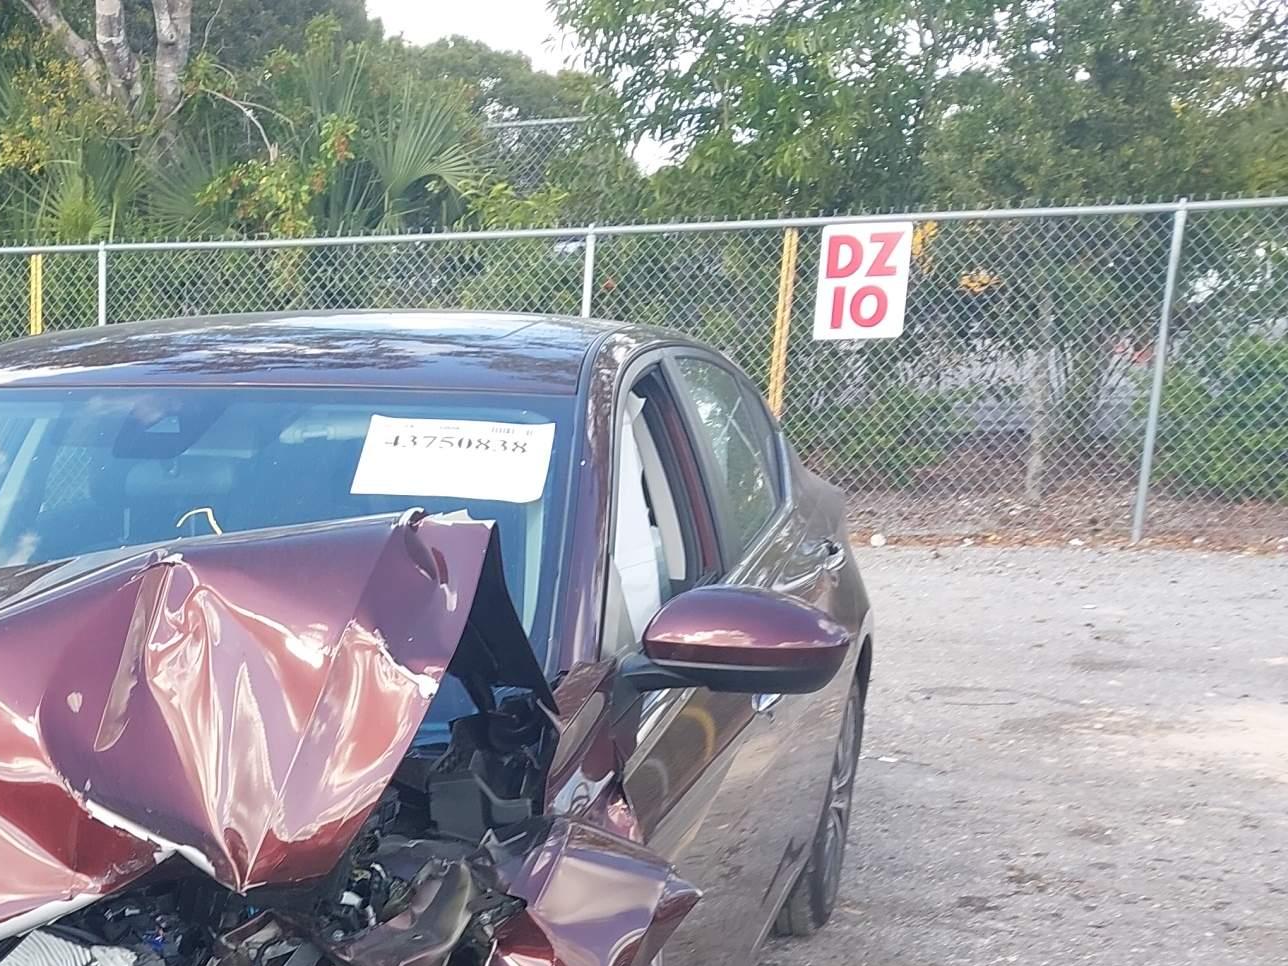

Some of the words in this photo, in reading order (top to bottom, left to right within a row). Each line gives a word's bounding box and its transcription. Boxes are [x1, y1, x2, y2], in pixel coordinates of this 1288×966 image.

[826, 231, 905, 279] DZ
[830, 285, 889, 330] 10
[384, 434, 528, 454] 43750838
